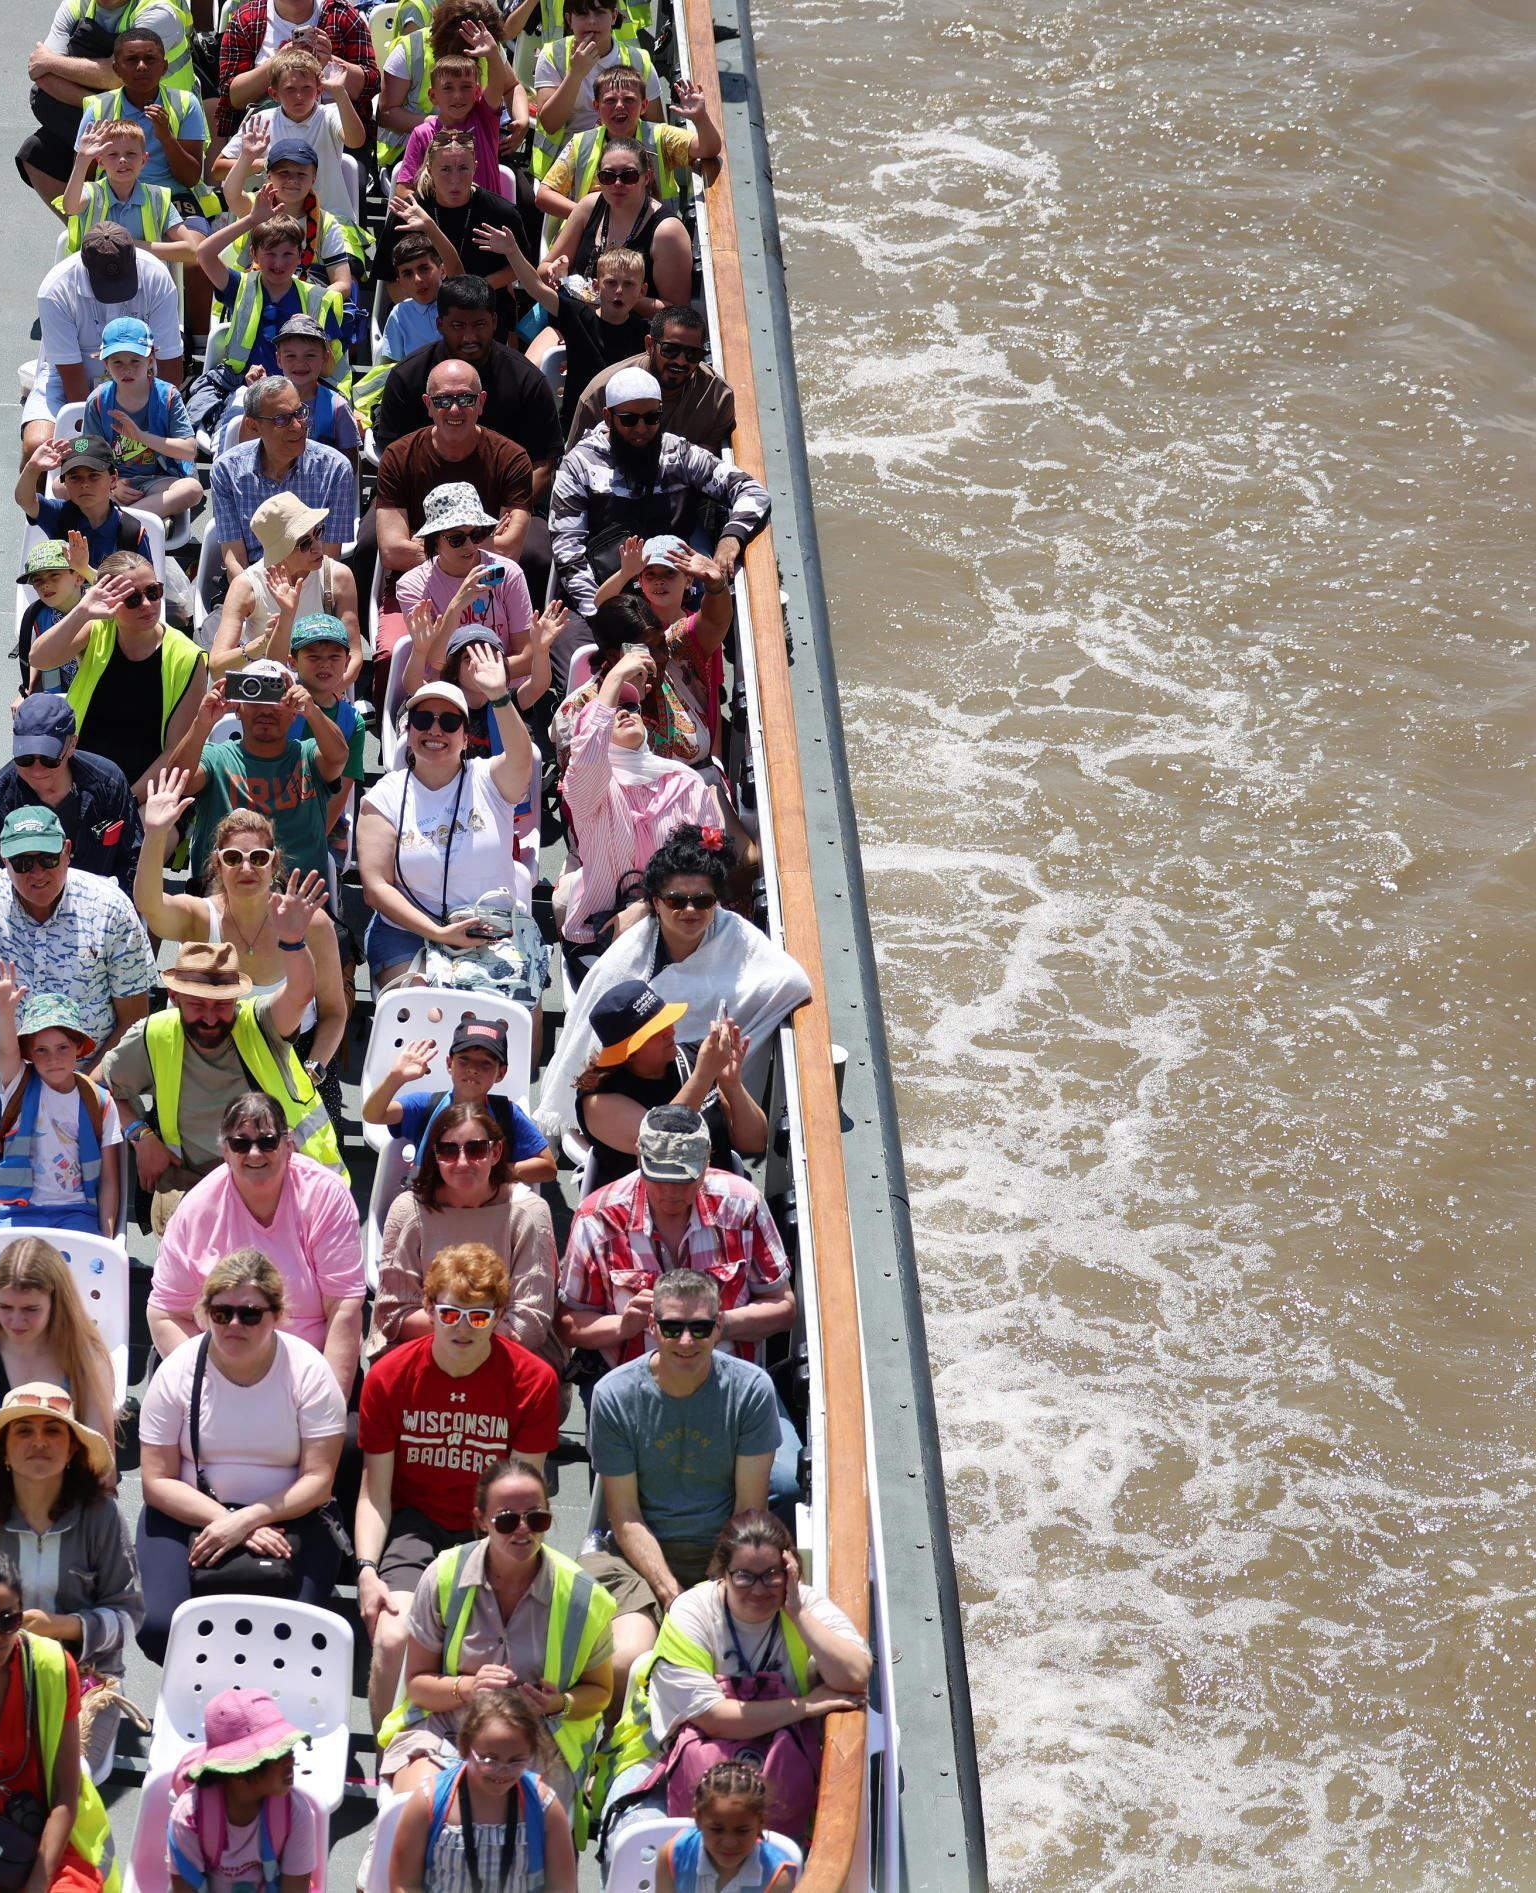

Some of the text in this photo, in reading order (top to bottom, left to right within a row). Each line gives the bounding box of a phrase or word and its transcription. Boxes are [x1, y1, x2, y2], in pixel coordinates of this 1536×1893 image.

[174, 200, 196, 214] 19
[403, 1409, 508, 1439] WISCONSIN
[407, 1446, 497, 1474] BADGERS
